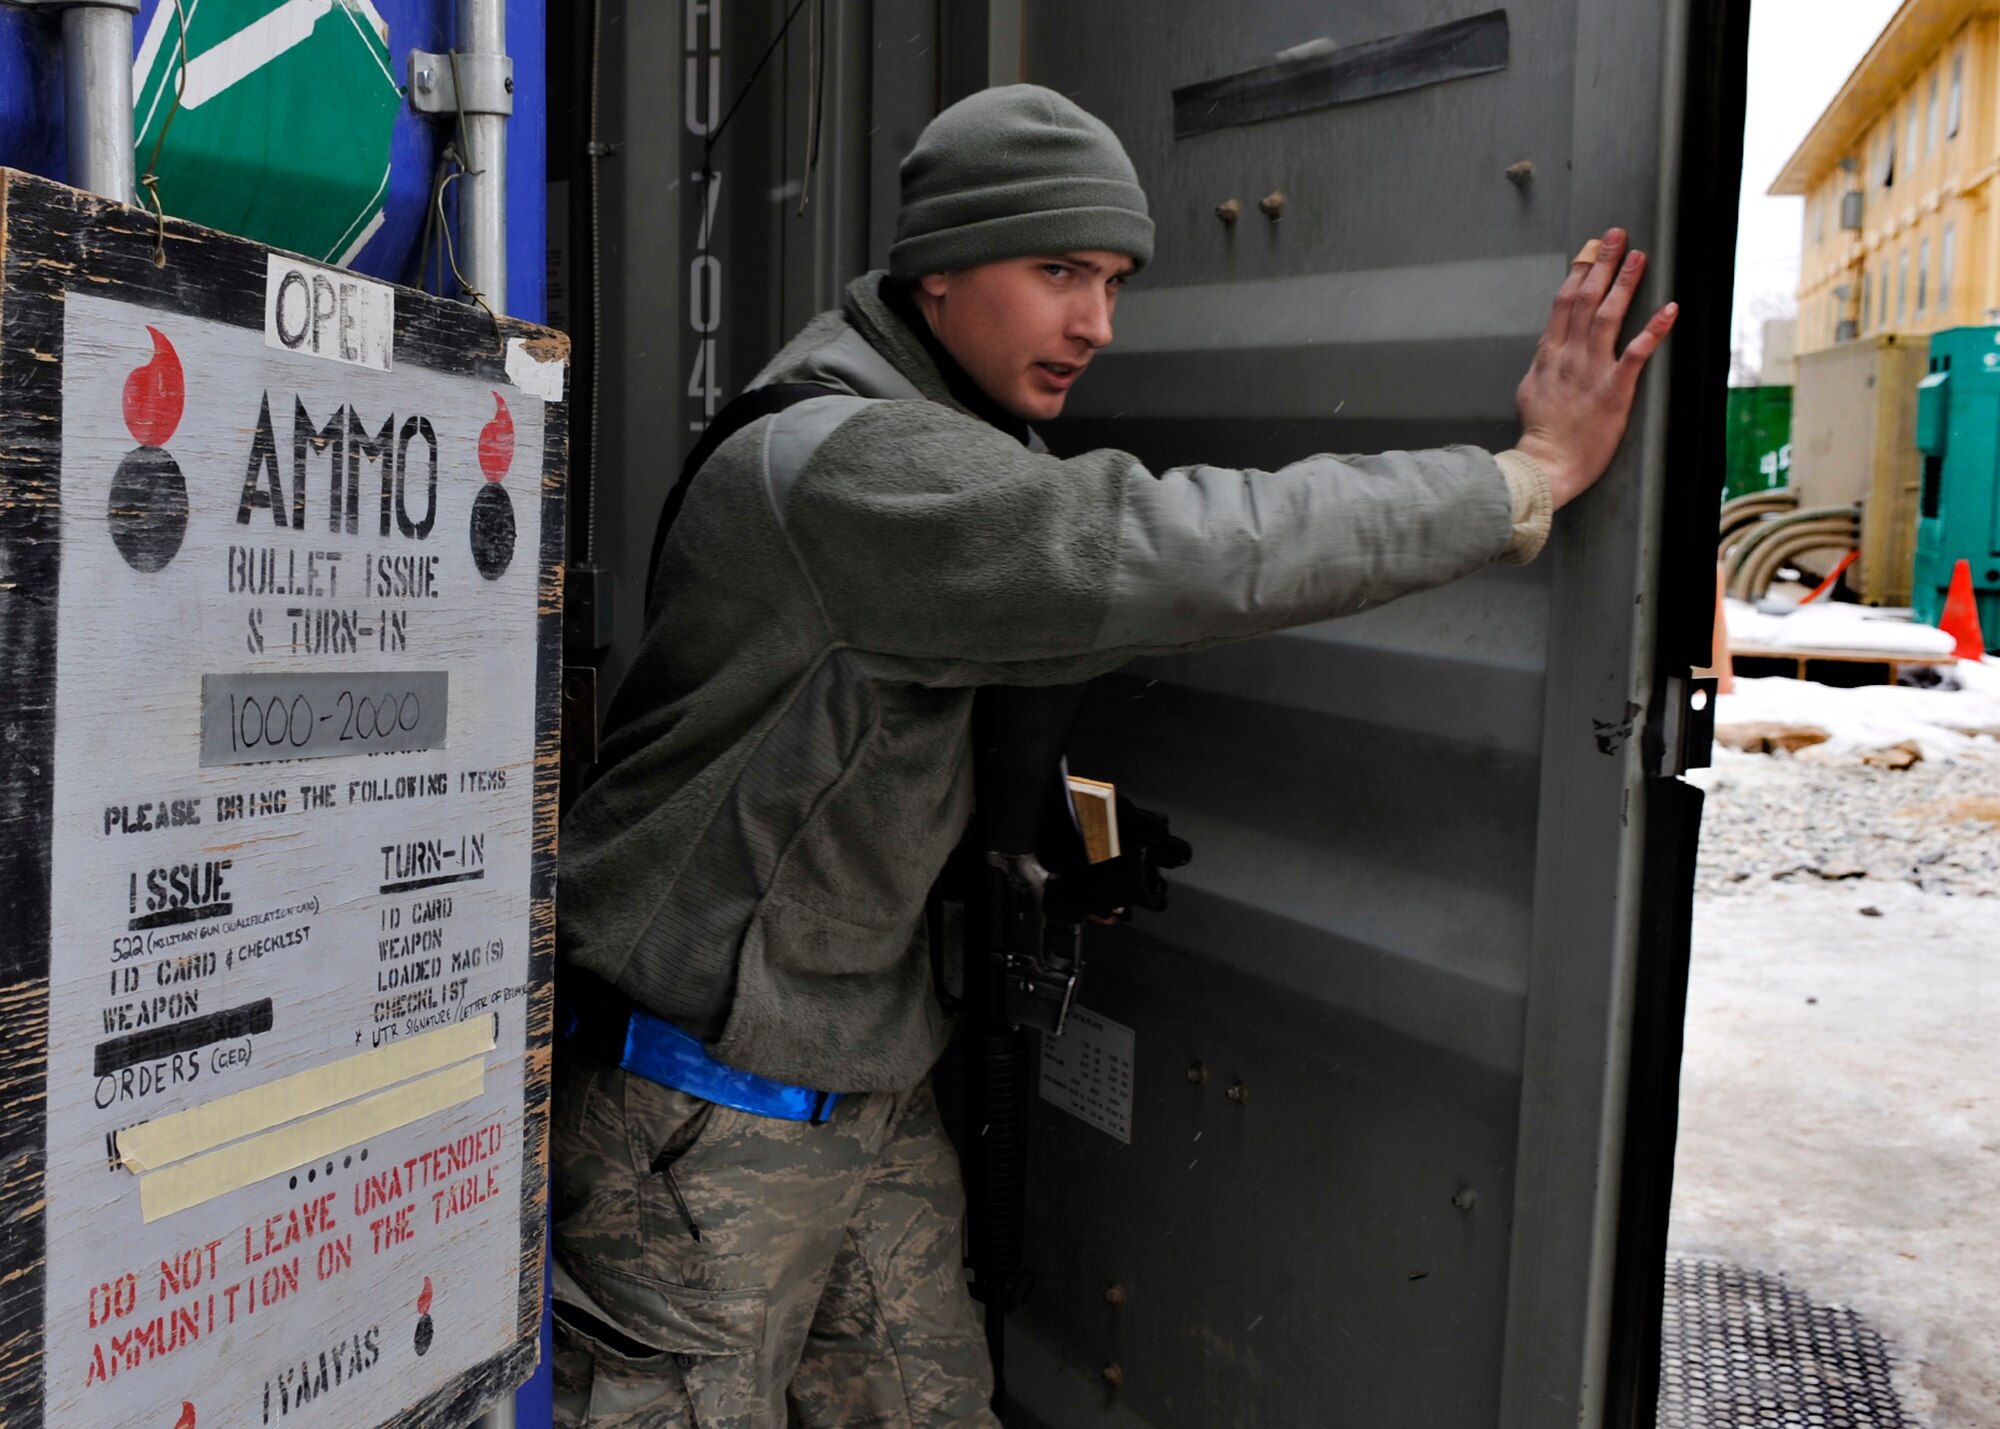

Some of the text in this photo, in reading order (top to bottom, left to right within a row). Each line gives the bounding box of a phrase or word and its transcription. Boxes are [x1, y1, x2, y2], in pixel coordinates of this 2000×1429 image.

[236, 389, 438, 540] AMMO
[228, 546, 439, 598] BULLET ISSUE
[287, 608, 406, 654] TURN-IN
[230, 691, 421, 752] 1000-2000
[104, 770, 507, 835] PLEASE BRING THE FOLLOWING ITEMS
[380, 832, 484, 880] TURN-IN
[129, 859, 233, 914] ISSUE
[200, 925, 220, 939] GUN
[223, 907, 294, 933] QUALIFICATION
[381, 897, 453, 931] ID CARD
[111, 966, 139, 996] ID
[157, 952, 217, 986] CARD
[239, 926, 311, 961] CHECKLIST
[379, 928, 443, 962] WEAPON
[378, 957, 441, 992] LOADED
[491, 990, 502, 1004] OF
[102, 988, 199, 1034] WEAPON
[374, 977, 468, 1023] CHECKLIST
[94, 1050, 200, 1110] ORDERS
[89, 1122, 502, 1329] DO NOT LEAVE UNATTENDED
[86, 1164, 500, 1388] AMMUNITION ON THE TABLE
